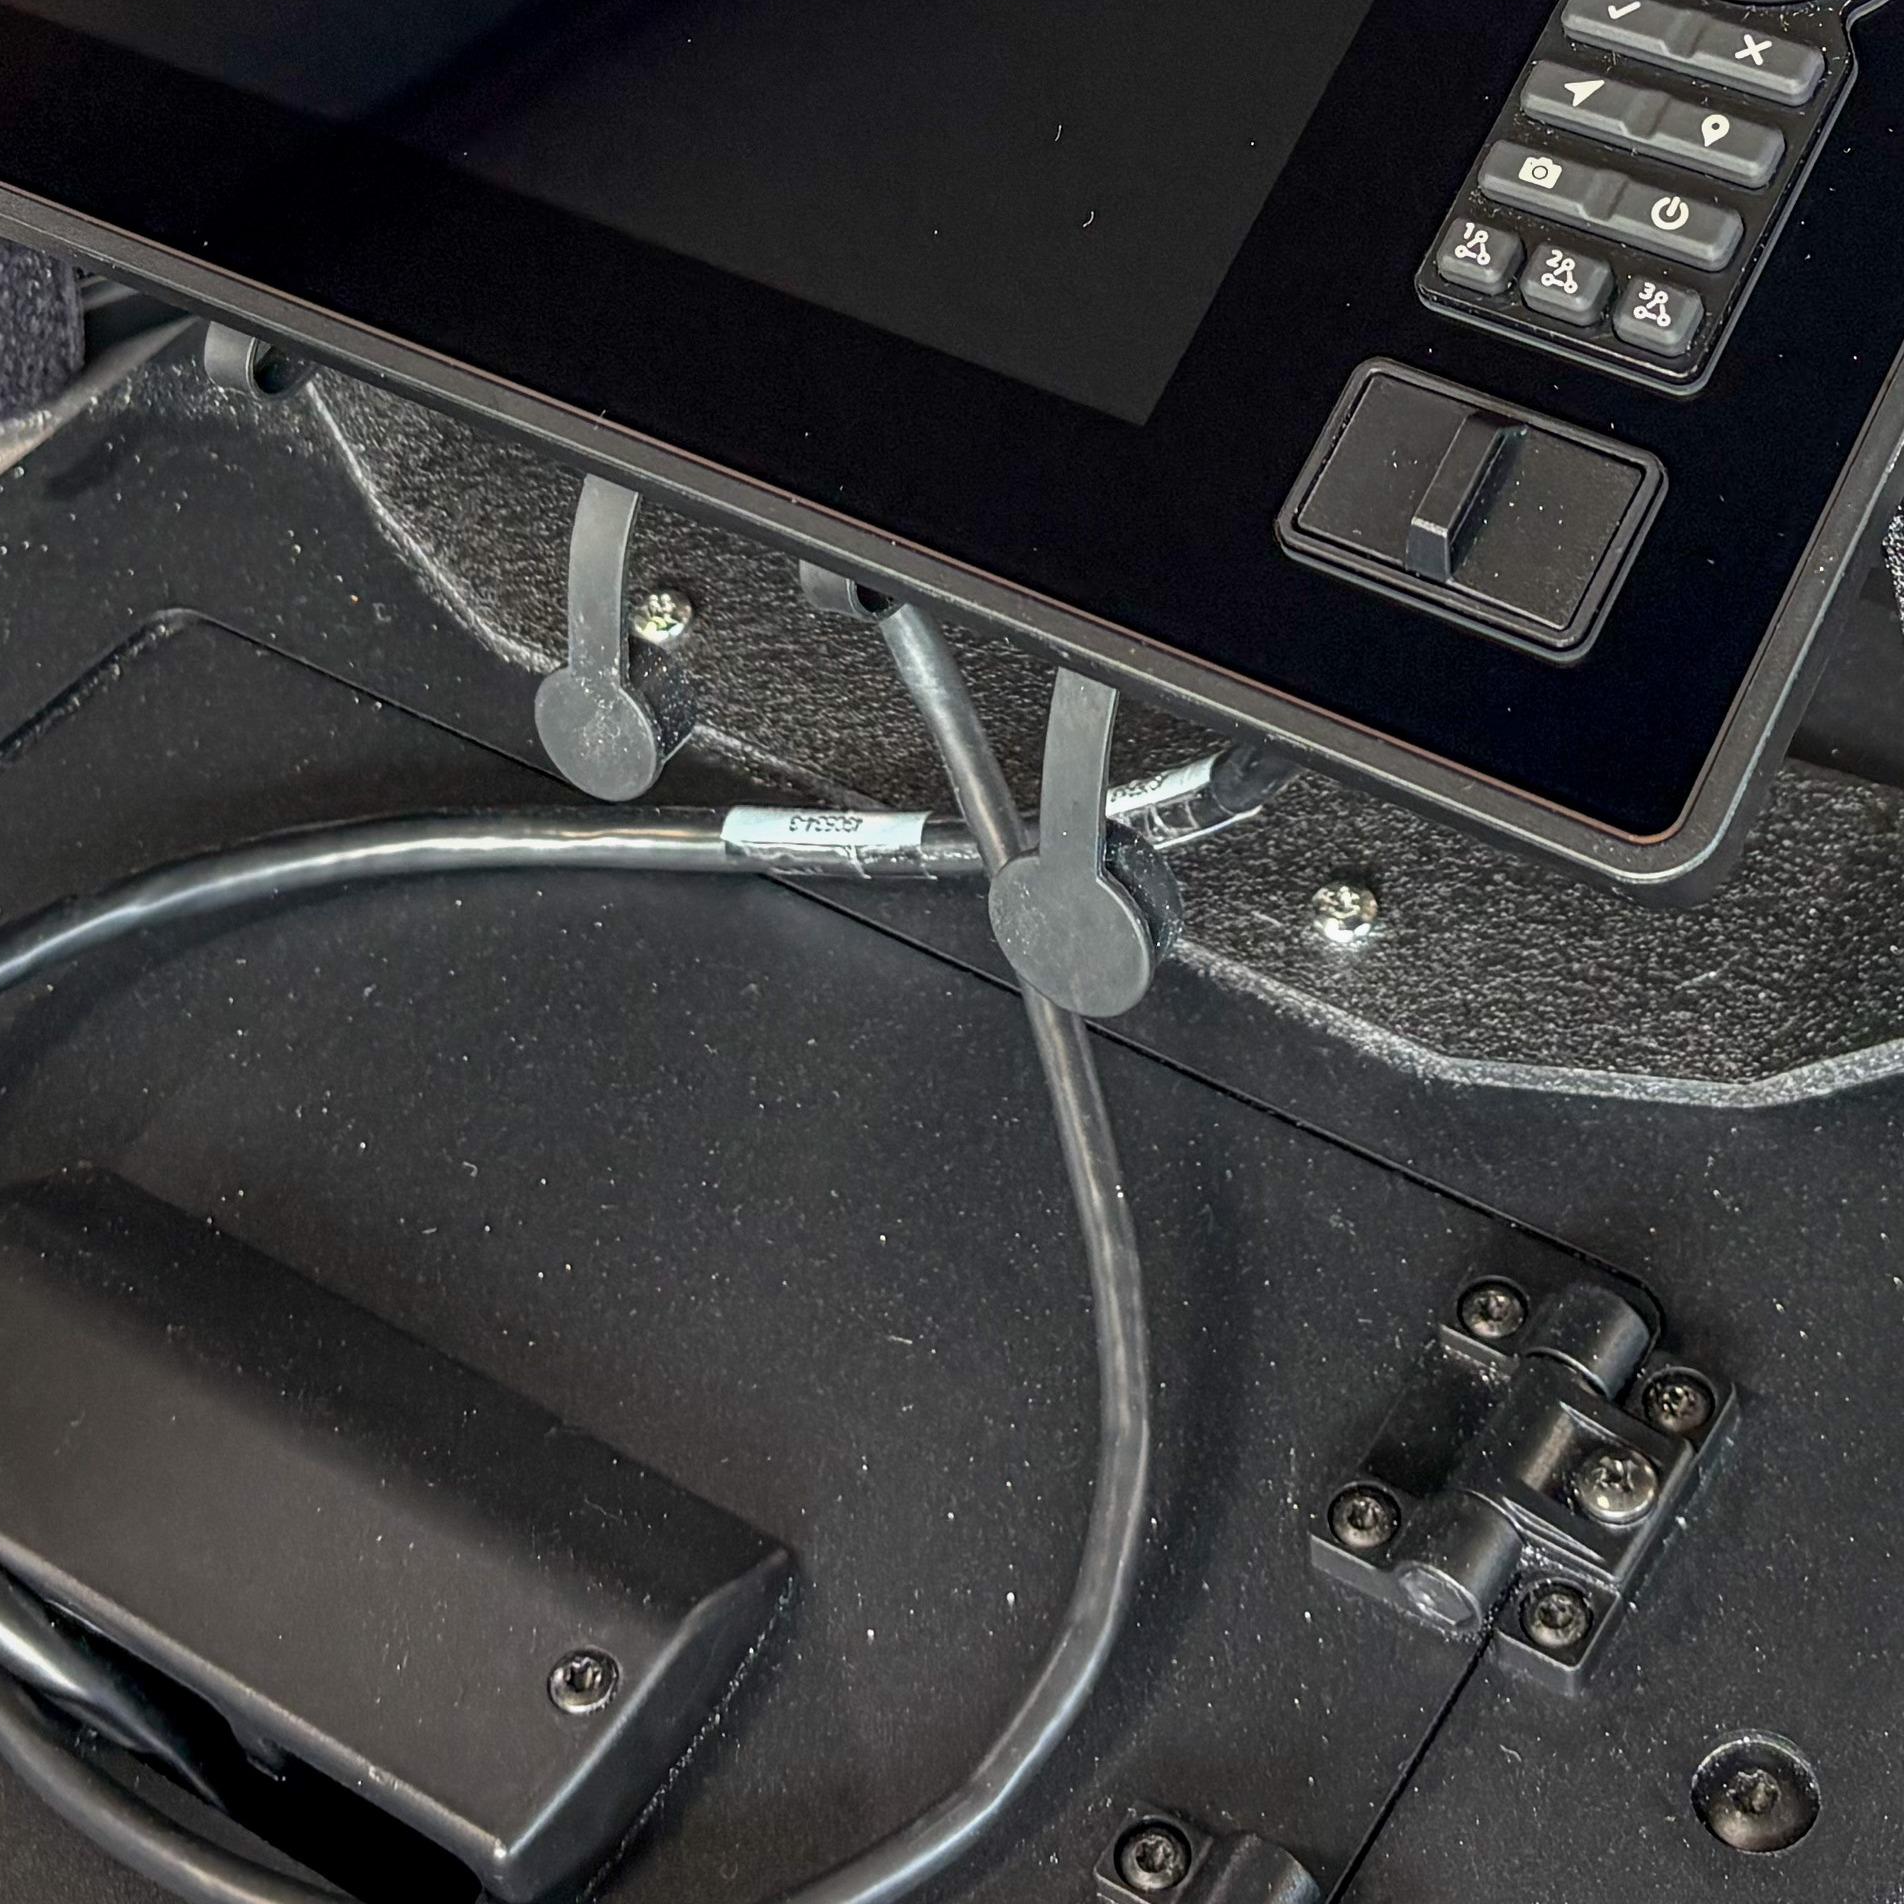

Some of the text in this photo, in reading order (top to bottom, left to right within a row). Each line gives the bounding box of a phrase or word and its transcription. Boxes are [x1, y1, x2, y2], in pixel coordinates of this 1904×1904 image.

[1463, 221, 1476, 240] 1
[1546, 249, 1564, 268] 2
[1638, 281, 1656, 300] 3
